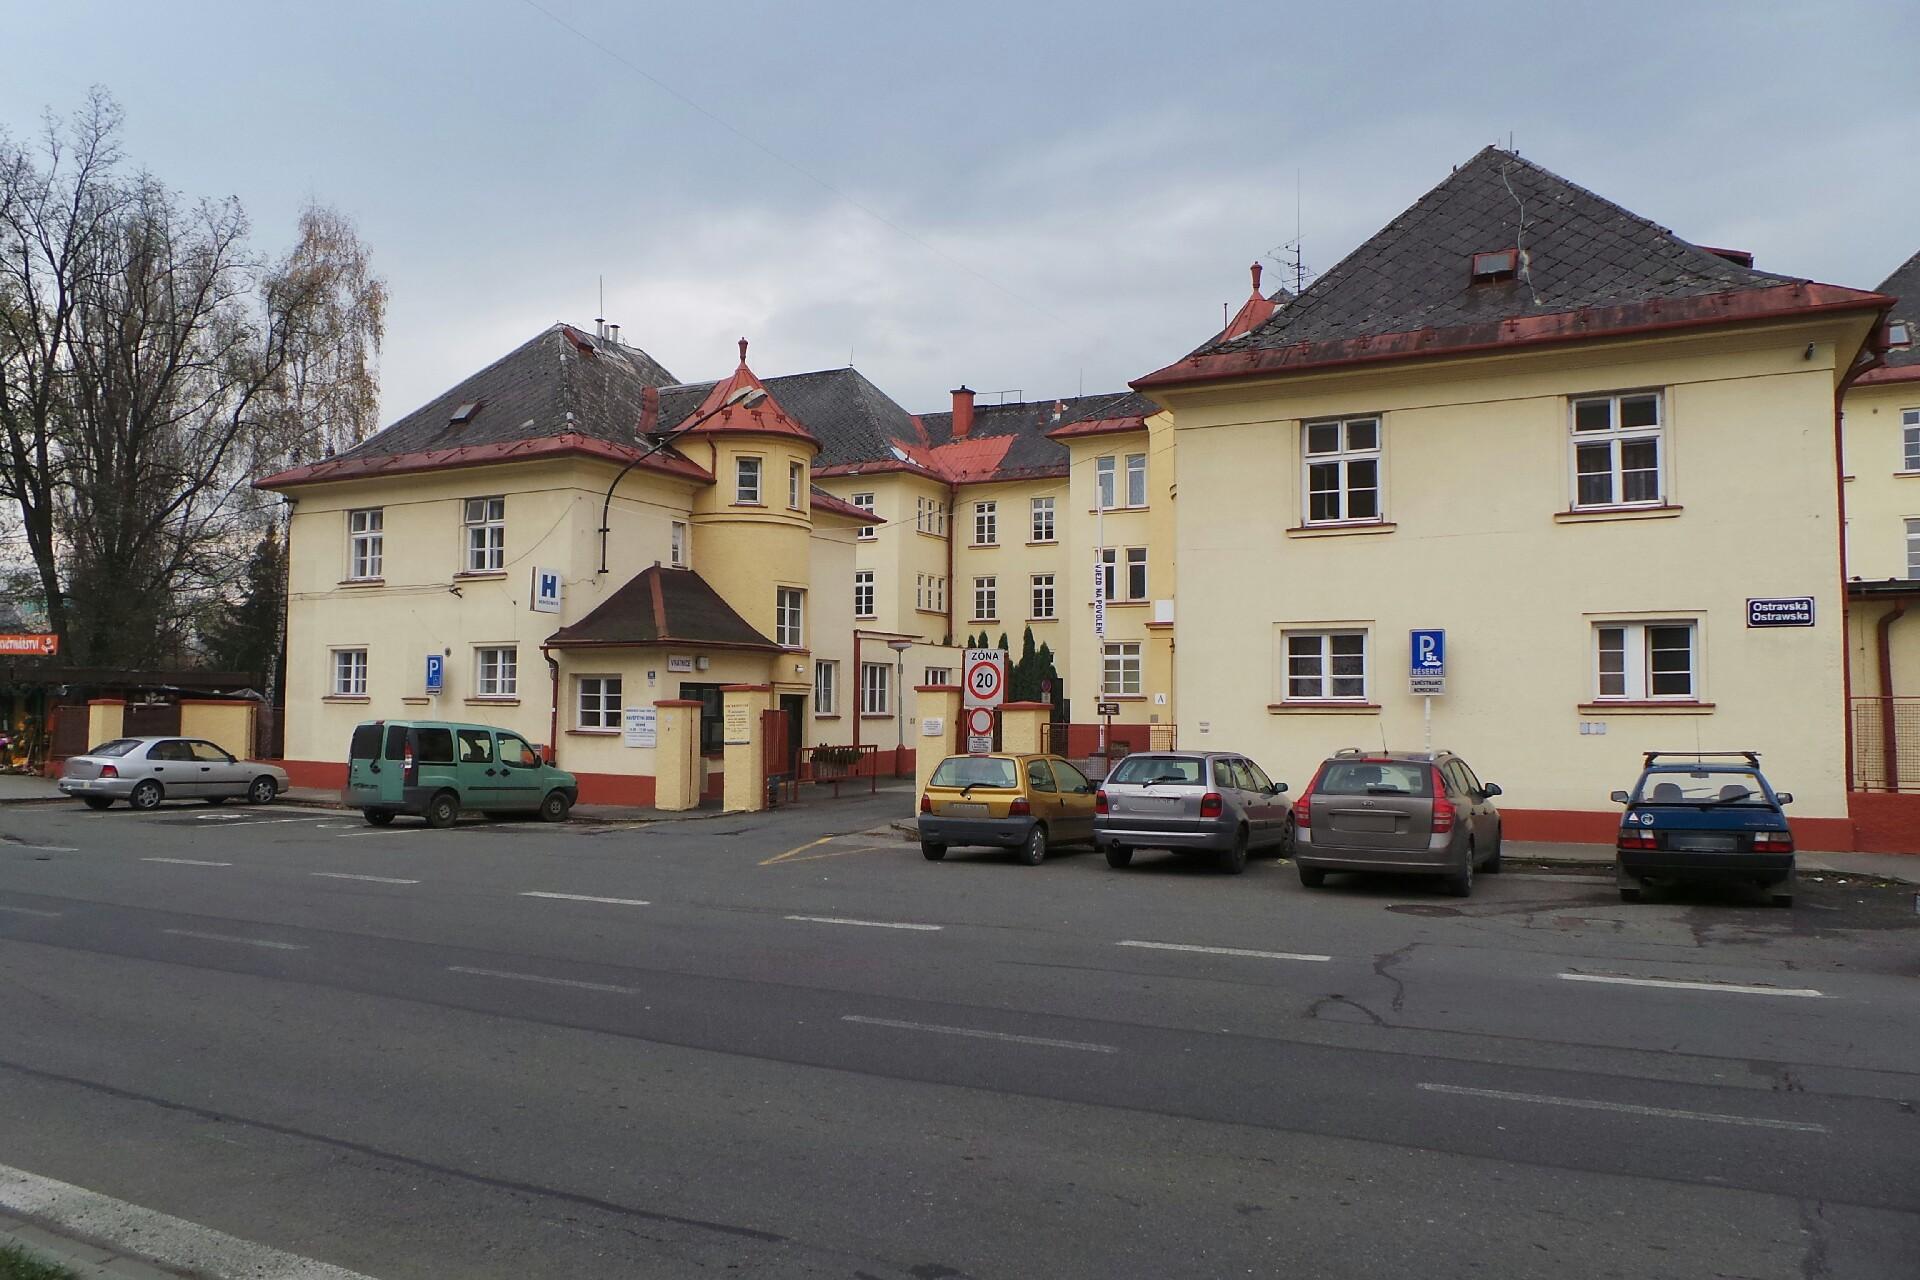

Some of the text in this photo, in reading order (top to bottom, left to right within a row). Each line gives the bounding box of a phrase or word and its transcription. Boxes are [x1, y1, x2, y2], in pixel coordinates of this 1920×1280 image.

[542, 574, 557, 598] H
[1095, 588, 1103, 598] NA
[1753, 601, 1809, 611] Ostravská
[1752, 611, 1809, 621] Ostrawska
[1419, 635, 1436, 661] P
[971, 650, 999, 661] ZÓNA
[430, 659, 439, 678] P
[976, 672, 993, 689] 20
